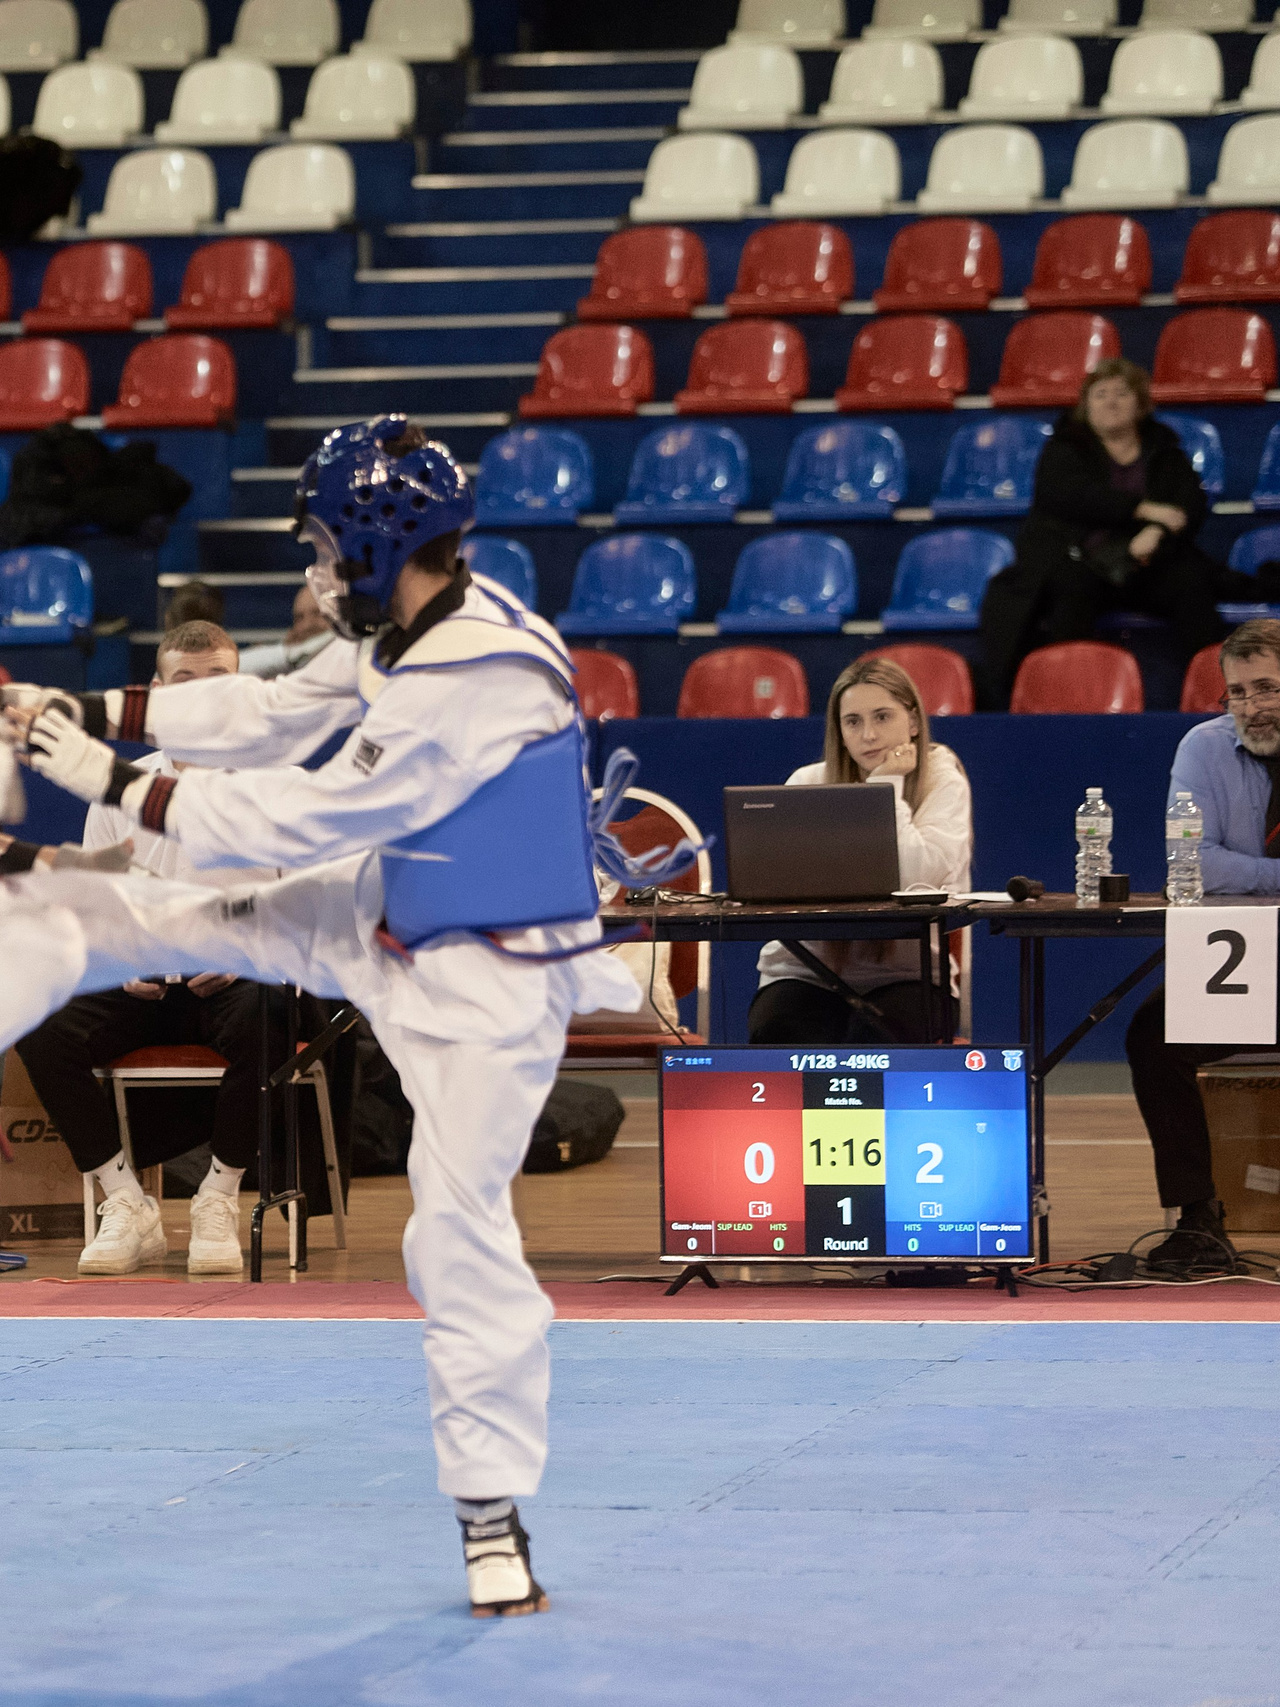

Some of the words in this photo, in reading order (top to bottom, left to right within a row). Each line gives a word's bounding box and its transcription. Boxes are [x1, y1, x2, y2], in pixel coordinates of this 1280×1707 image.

[1206, 929, 1249, 995] 2
[790, 1054, 837, 1071] 1/128
[840, 1054, 890, 1069] -49KG
[752, 1082, 766, 1103] 2
[829, 1078, 858, 1092] 213
[923, 1082, 933, 1102] 1
[7, 1119, 66, 1143] CDE
[809, 1138, 882, 1167] 1:16
[744, 1142, 775, 1184] 0
[915, 1142, 944, 1184] 2
[837, 1197, 852, 1225] 1
[9, 1212, 40, 1233] XL
[717, 1223, 732, 1231] SUP
[733, 1223, 753, 1231] LEAD
[770, 1223, 787, 1231] HITS
[904, 1224, 922, 1232] HITS
[938, 1224, 954, 1232] SUP
[955, 1224, 975, 1232] LEAD
[687, 1237, 698, 1250] 0
[773, 1237, 785, 1251] 0
[823, 1237, 869, 1251] Round
[907, 1238, 919, 1252] 0
[995, 1238, 1006, 1252] 0
